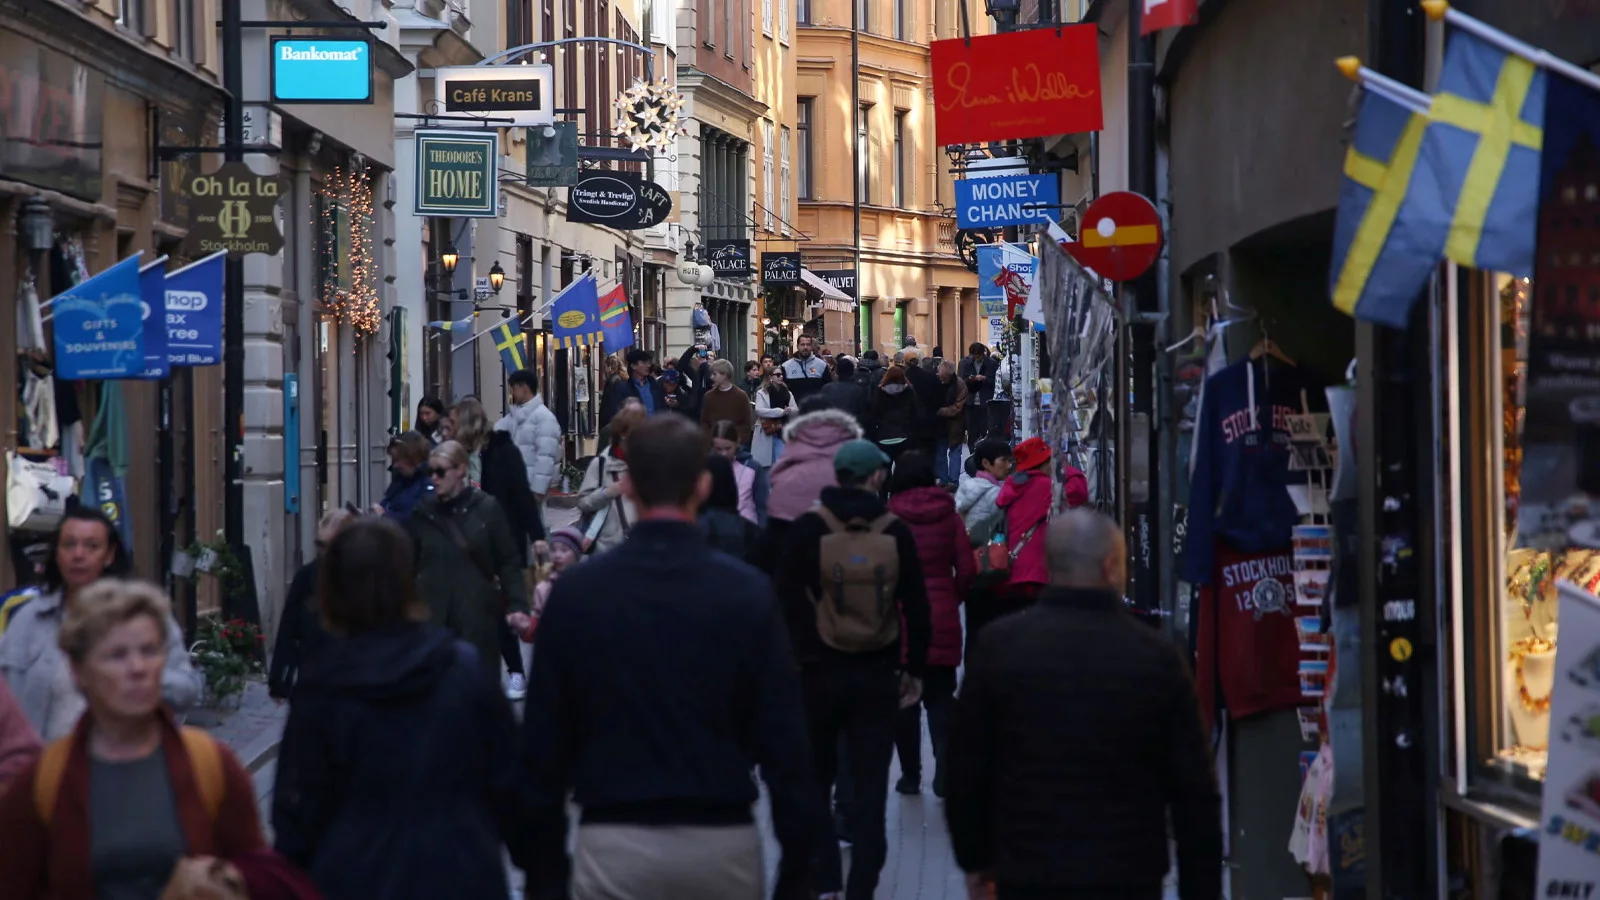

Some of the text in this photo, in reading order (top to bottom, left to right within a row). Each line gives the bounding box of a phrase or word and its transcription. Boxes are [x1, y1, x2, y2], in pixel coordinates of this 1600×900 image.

[453, 88, 533, 103] Café Krans
[430, 149, 483, 164] THEODORE'S
[191, 176, 278, 197] Oh la la
[429, 169, 482, 199] HOME
[574, 188, 598, 198] Trångt
[607, 191, 634, 200] Trevligt
[972, 180, 1040, 201] MONEY
[600, 199, 629, 207] Handicraft
[967, 201, 1048, 223] CHANGE
[200, 239, 269, 251] Stockholm
[711, 259, 747, 270] PALACE
[764, 270, 798, 280] PALACE
[828, 276, 855, 288] VALVET
[82, 319, 118, 331] GIFTS
[95, 331, 104, 340] &
[65, 341, 137, 353] SOUVENIRS
[187, 354, 214, 364] Blue
[1546, 879, 1595, 898] ONLY
